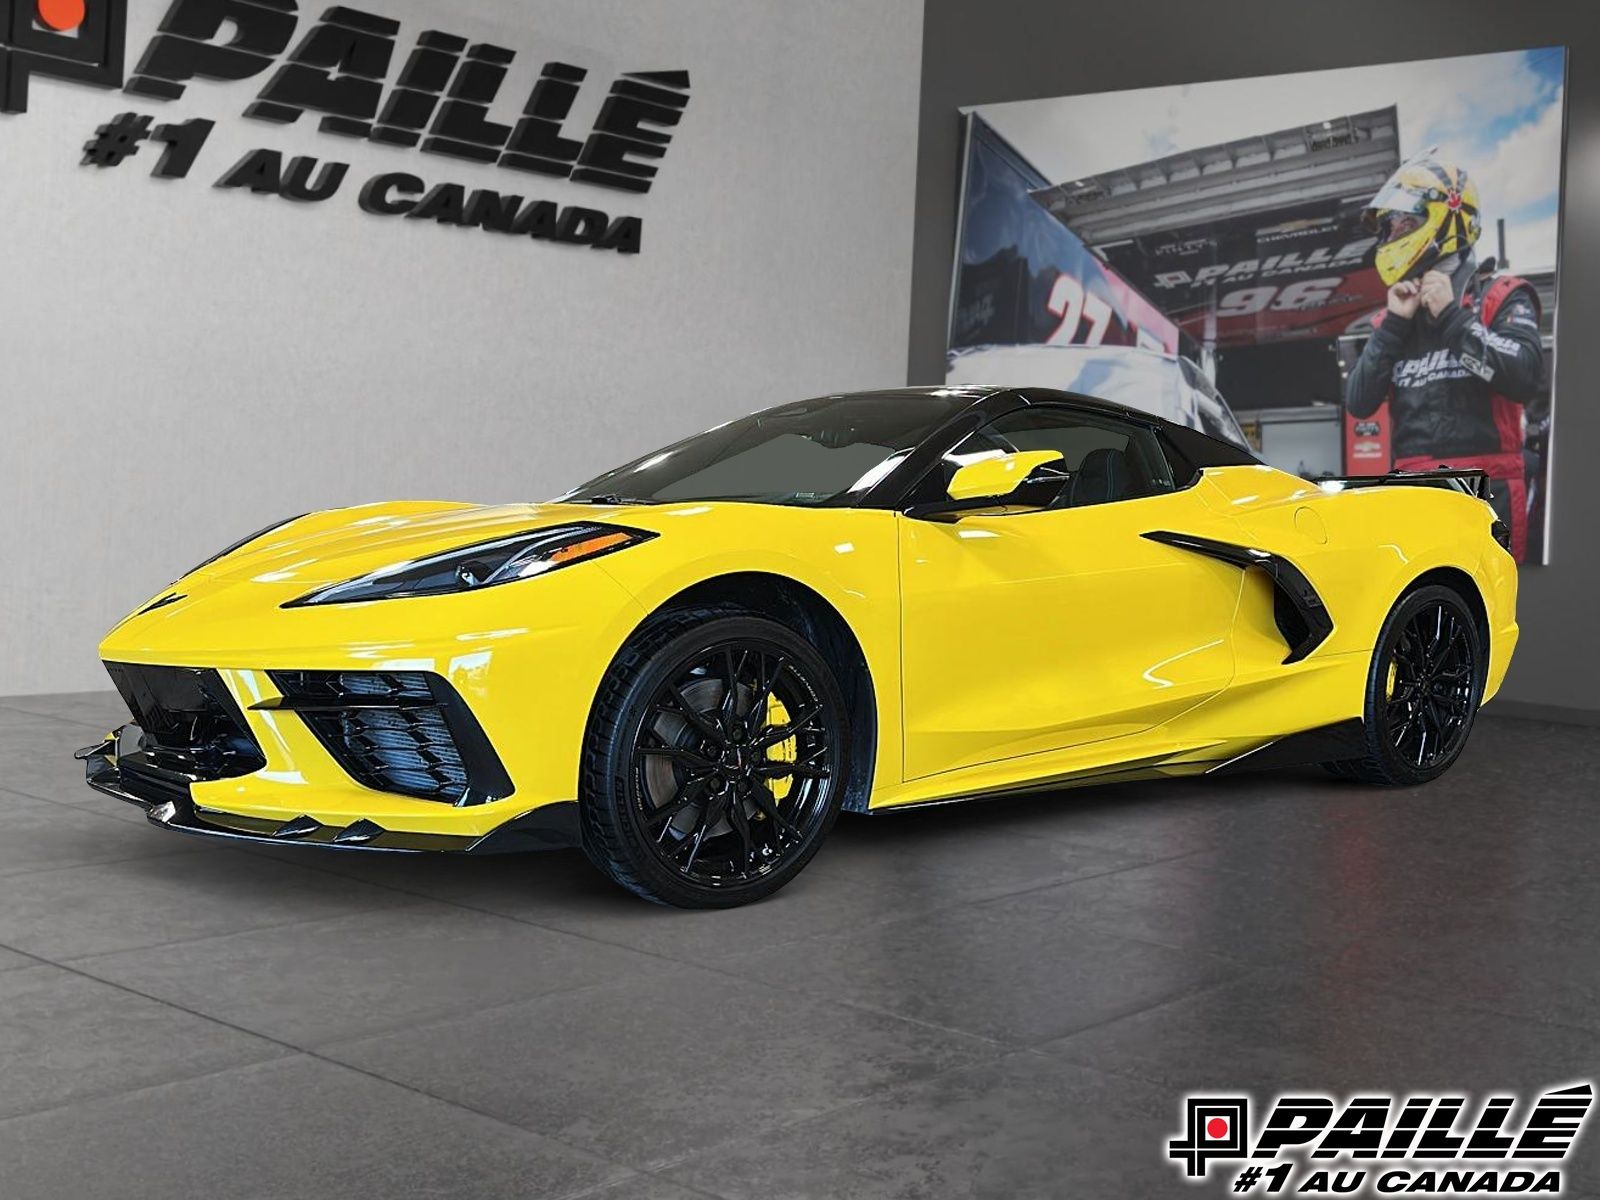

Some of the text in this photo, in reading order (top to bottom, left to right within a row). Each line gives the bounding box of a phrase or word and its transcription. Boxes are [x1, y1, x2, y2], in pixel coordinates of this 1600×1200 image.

[122, 0, 690, 194] PAILLÉ
[79, 111, 643, 254] #1 AU CANADA
[1216, 277, 1343, 318] 96
